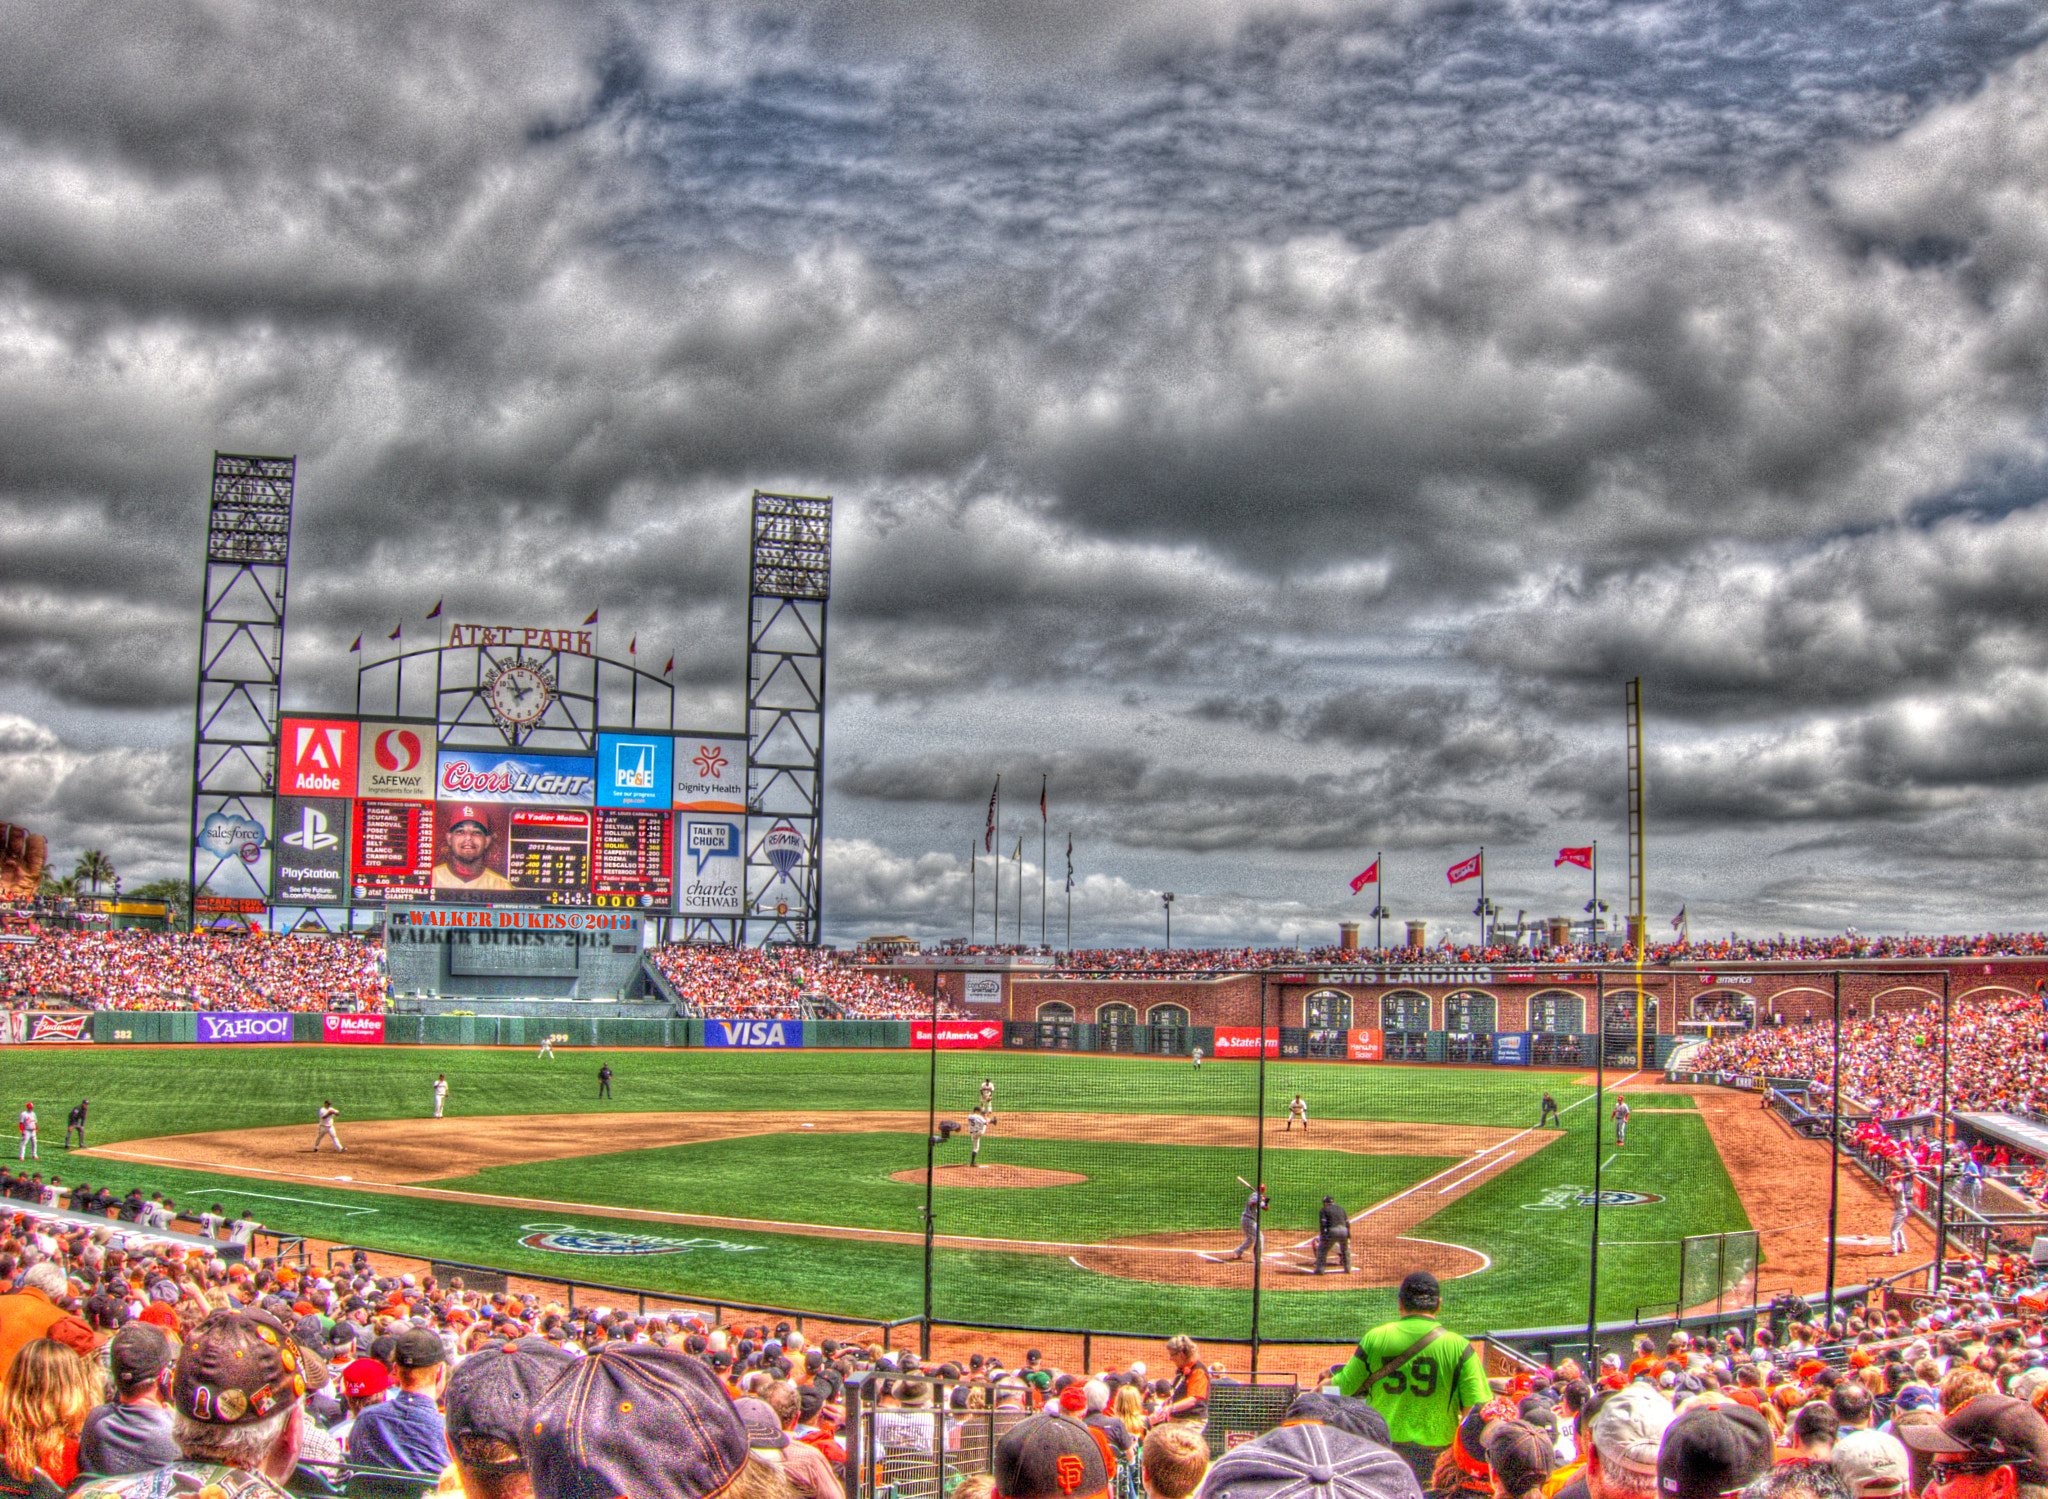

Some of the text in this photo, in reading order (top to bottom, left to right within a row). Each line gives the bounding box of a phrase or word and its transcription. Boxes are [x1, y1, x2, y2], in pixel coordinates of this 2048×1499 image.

[447, 624, 592, 656] AT&T PARK
[296, 773, 340, 790] Adobe
[372, 775, 421, 786] SAFEWAY
[443, 761, 589, 794] Coors LIGHT
[618, 769, 651, 785] PG&E
[678, 783, 741, 794] Dignity Health
[207, 826, 259, 844] salesforce
[694, 827, 713, 835] TALK
[693, 837, 725, 846] CHUCK
[769, 834, 800, 847] RE/MAX
[281, 867, 339, 880] PlayStation
[687, 880, 738, 896] charles
[597, 896, 606, 907] 0
[612, 896, 620, 907] 0
[626, 896, 635, 907] 0
[686, 896, 738, 907] SCHWAB
[1385, 967, 1494, 984] LANDING
[1716, 974, 1752, 984] america
[33, 1020, 84, 1032] Budweiser
[203, 1016, 288, 1039] YAHOO!
[340, 1018, 382, 1030] McAfee
[114, 1030, 132, 1039] 382
[550, 1034, 568, 1042] 399
[718, 1022, 786, 1046] VISA
[916, 1031, 978, 1040] Ban of America
[1283, 1046, 1298, 1054] 365
[1618, 1056, 1636, 1065] 309
